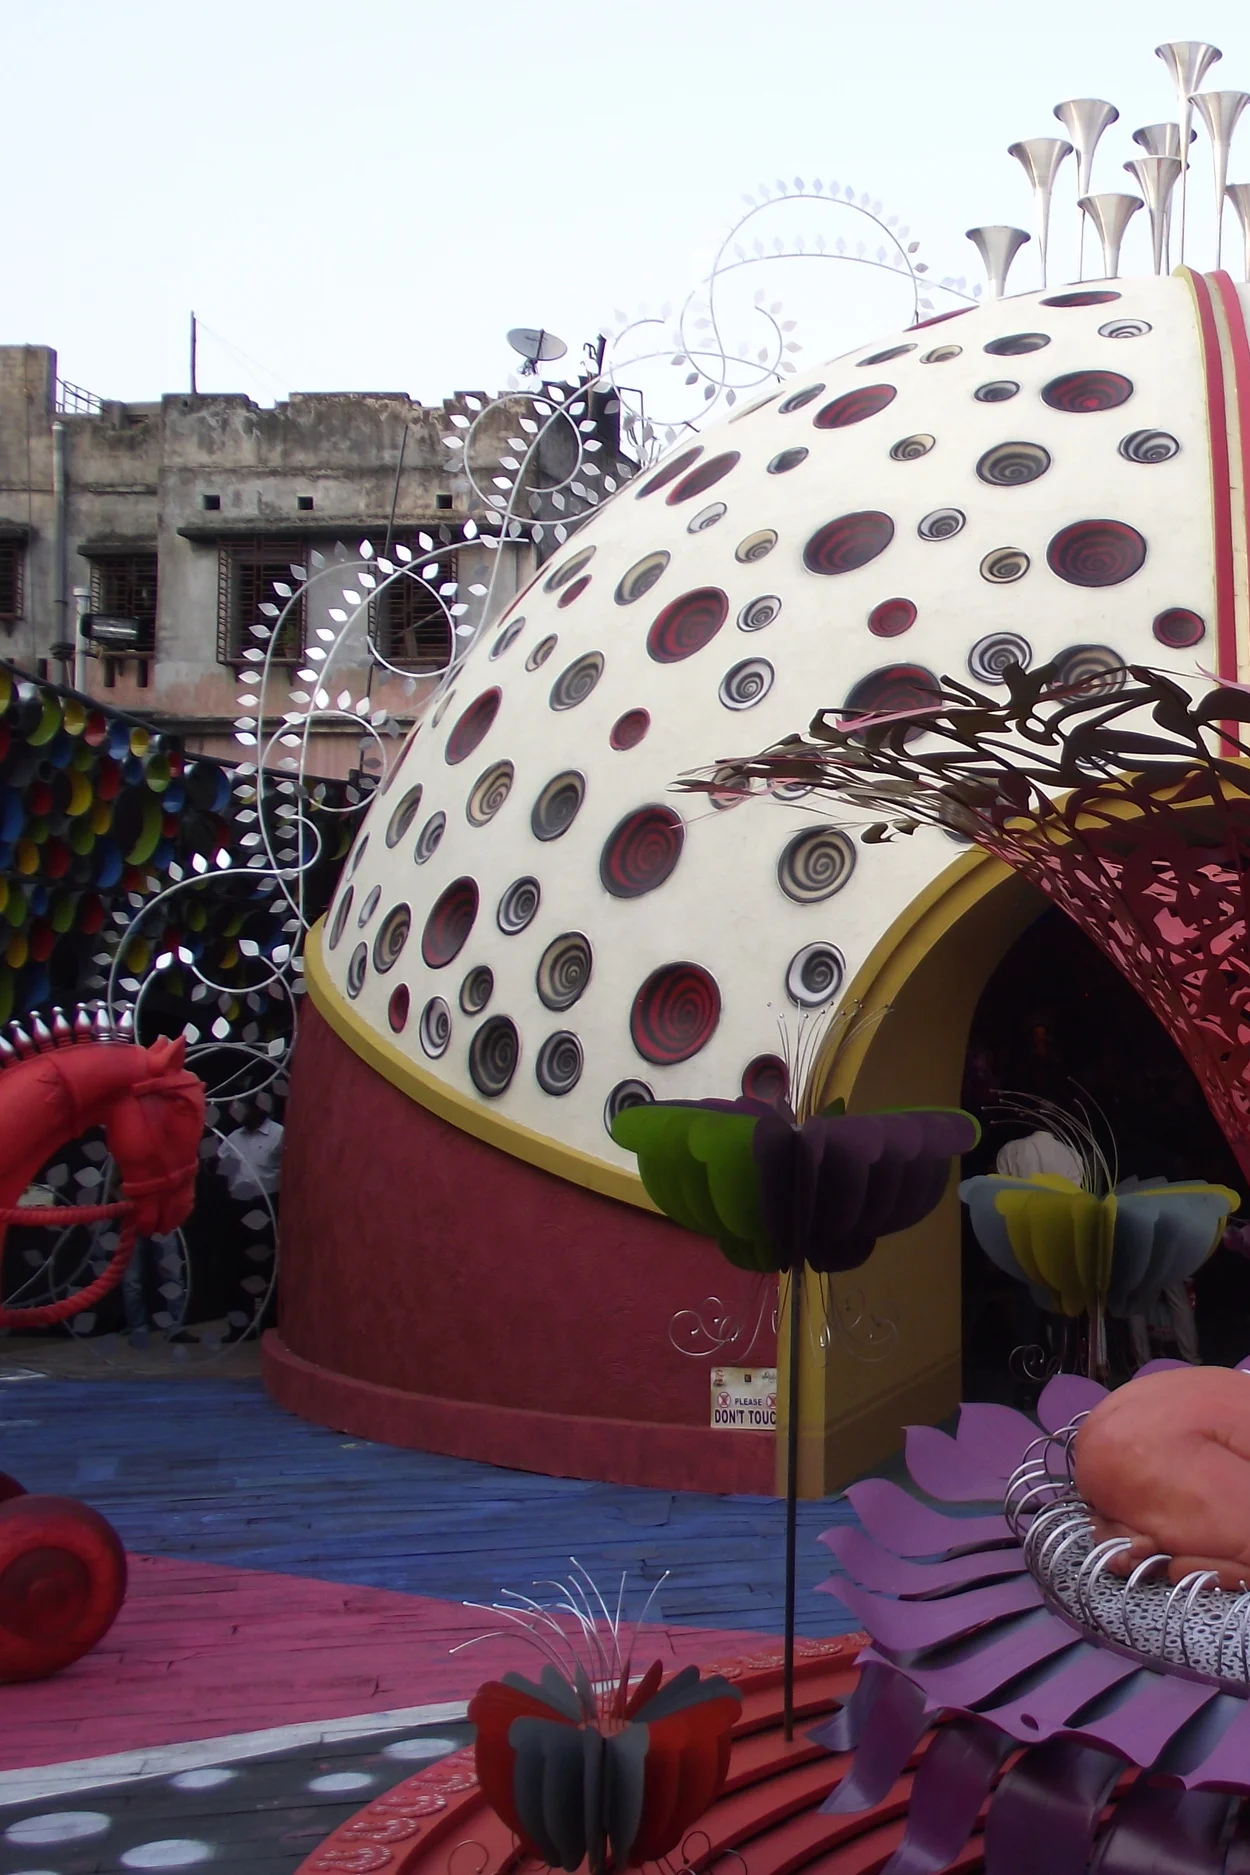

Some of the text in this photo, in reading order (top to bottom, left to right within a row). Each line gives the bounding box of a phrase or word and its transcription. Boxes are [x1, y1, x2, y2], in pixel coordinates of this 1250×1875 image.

[734, 1397, 762, 1406] PLEASE
[714, 1409, 776, 1425] DON'T TOUC
